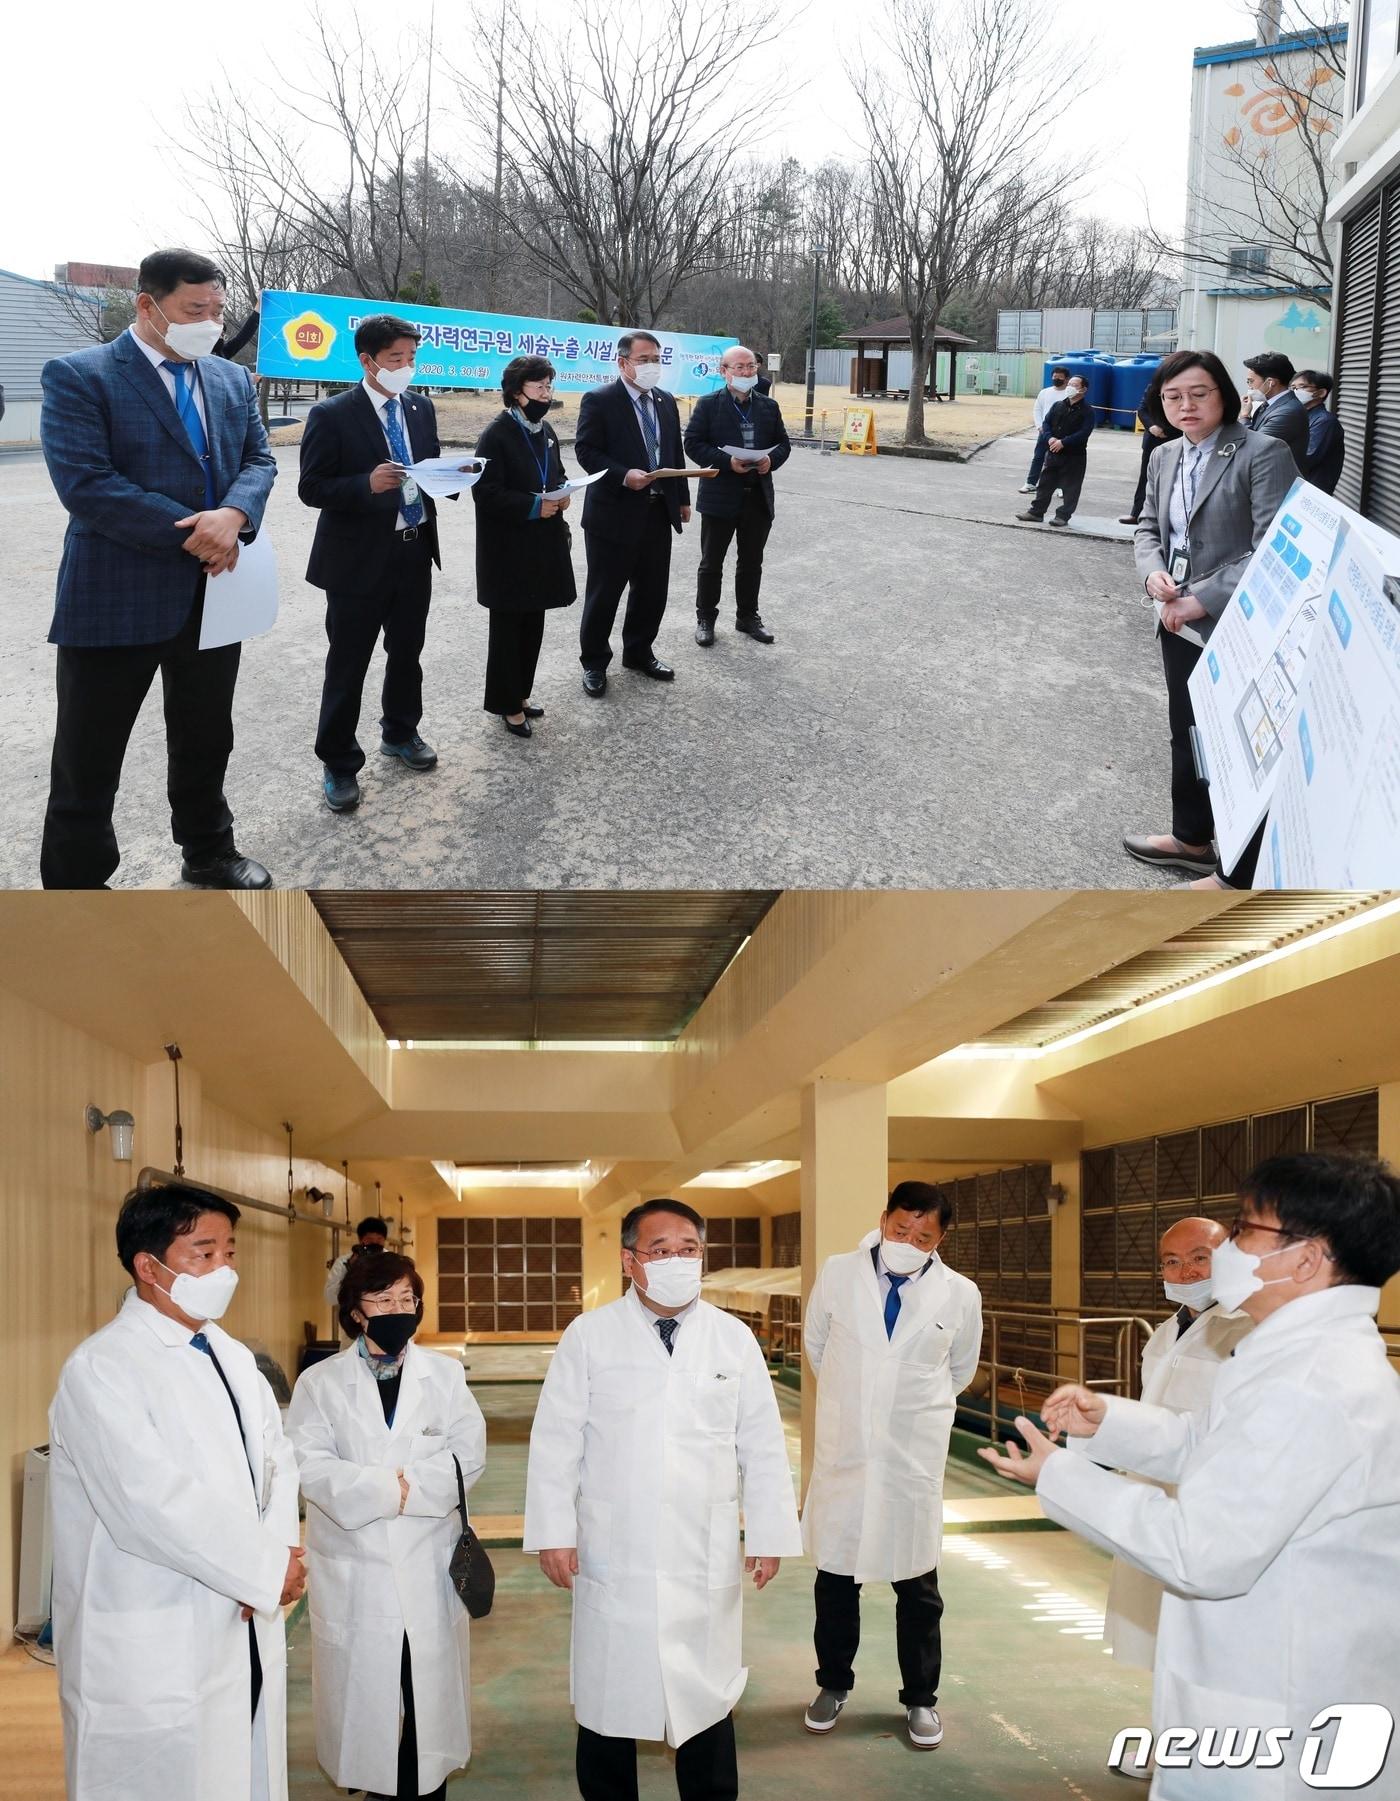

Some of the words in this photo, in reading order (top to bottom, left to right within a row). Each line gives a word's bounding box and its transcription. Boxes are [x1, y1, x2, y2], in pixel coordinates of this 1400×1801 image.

[297, 330, 322, 345] 의회
[517, 334, 580, 360] 세슘누출
[660, 346, 674, 365] 문
[419, 364, 445, 375] 2020.
[448, 365, 458, 376] 3.
[560, 371, 620, 385] 원자력안전특별위
